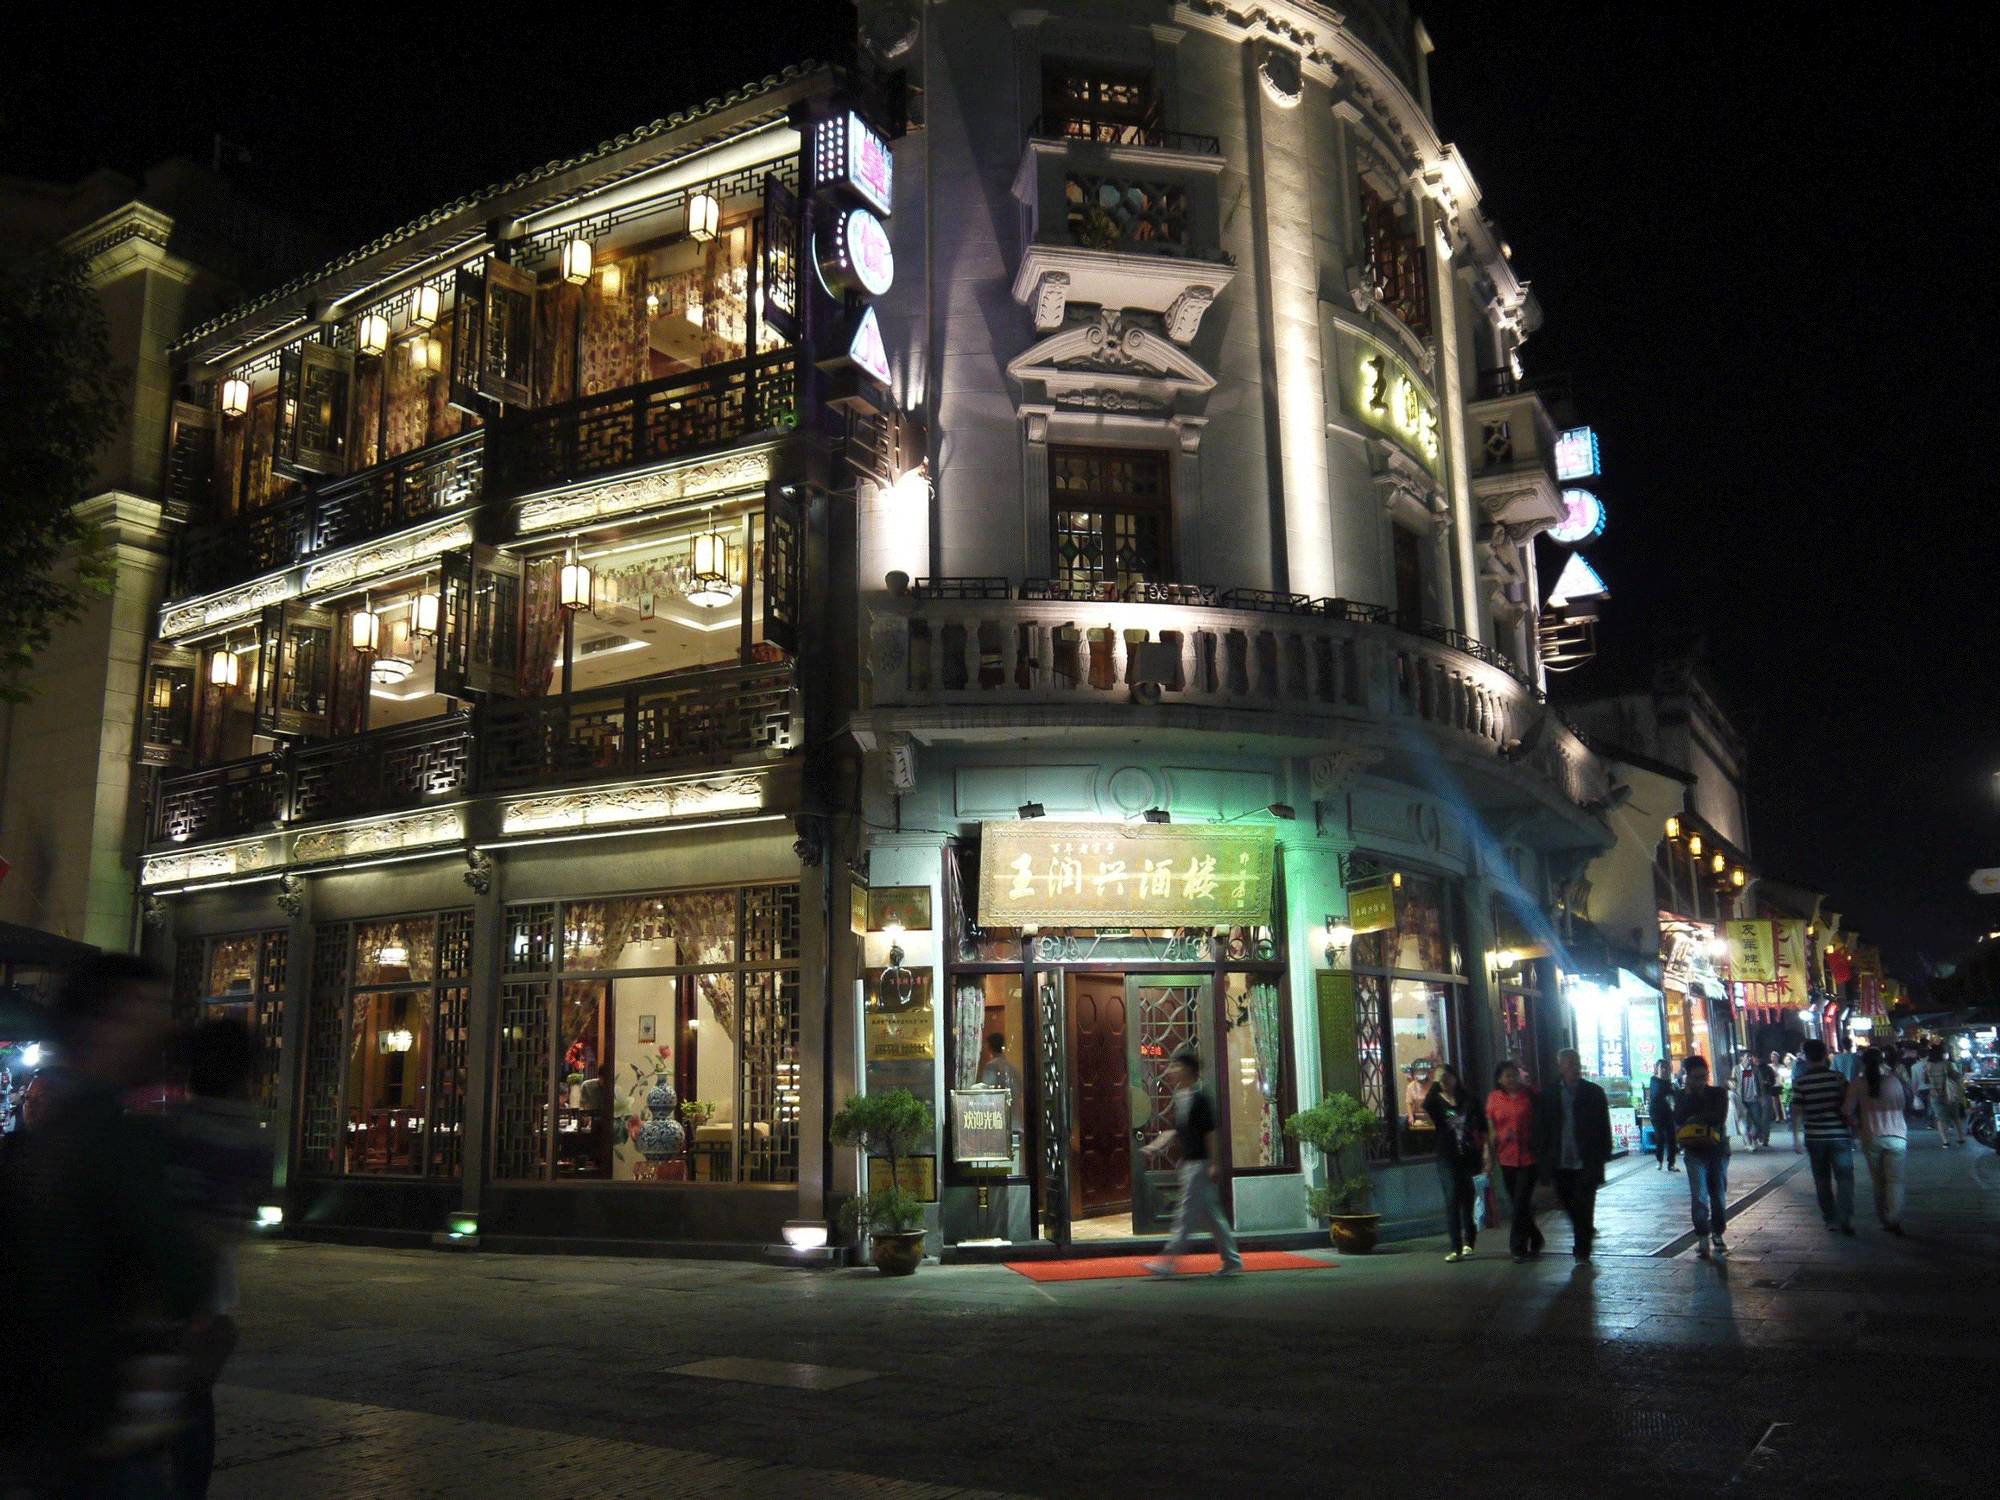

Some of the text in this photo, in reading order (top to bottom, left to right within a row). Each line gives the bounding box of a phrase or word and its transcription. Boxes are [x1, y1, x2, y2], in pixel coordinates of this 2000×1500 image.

[1008, 852, 1218, 900] 王润兴酒楼
[963, 1110, 1003, 1129] 欢迎光临
